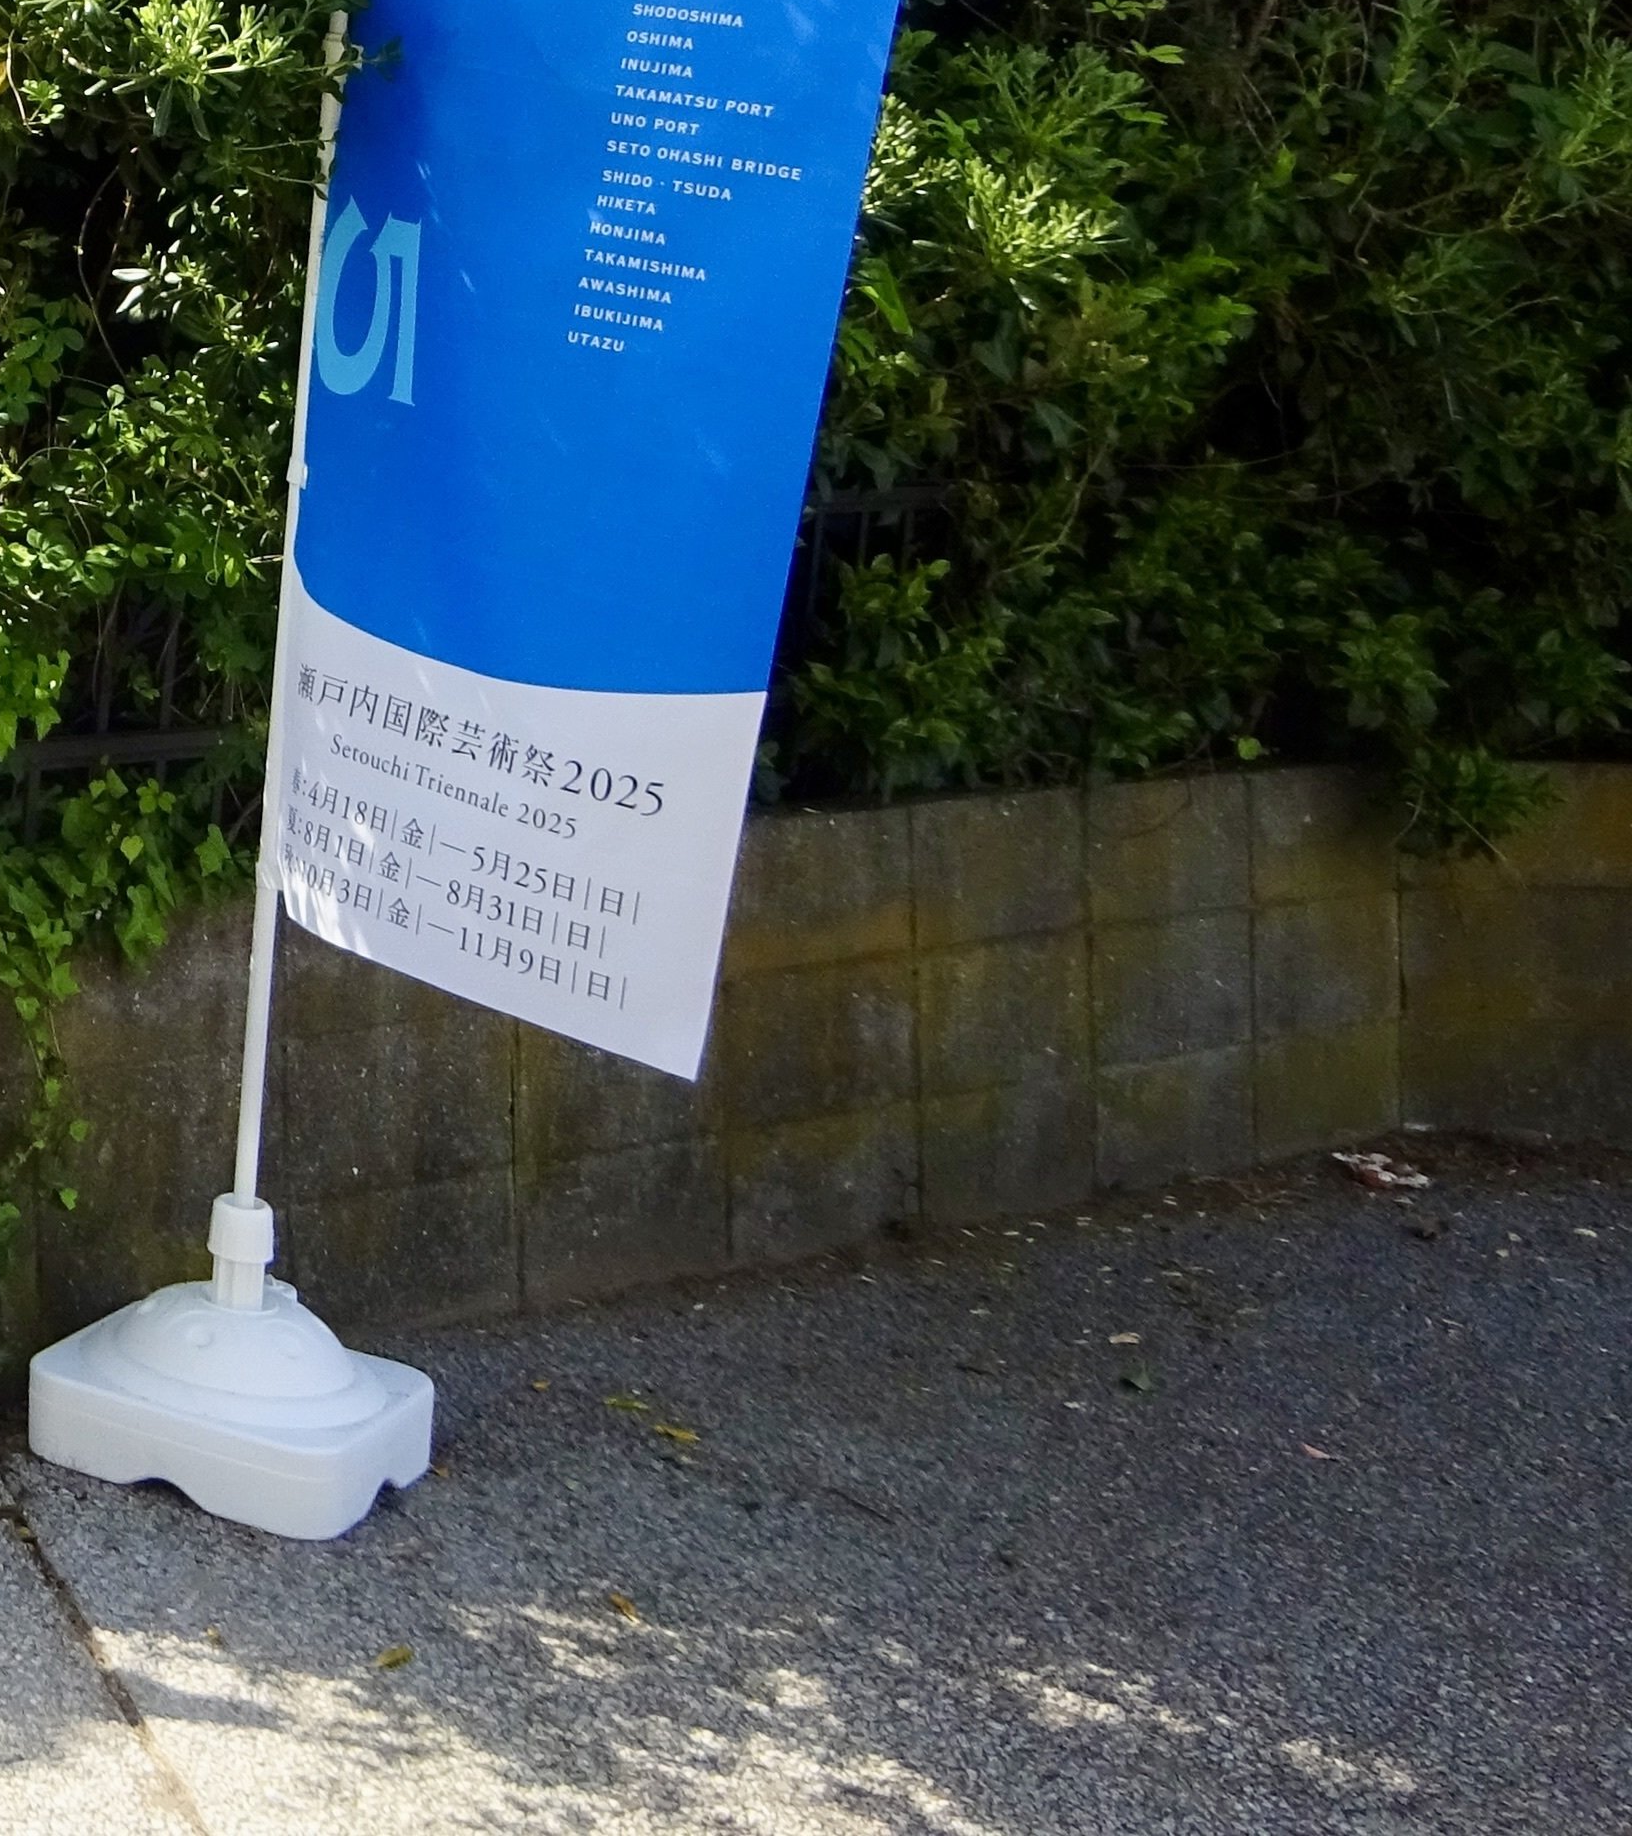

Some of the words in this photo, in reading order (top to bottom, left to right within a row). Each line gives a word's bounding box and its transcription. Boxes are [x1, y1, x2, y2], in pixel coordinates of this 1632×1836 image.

[632, 3, 743, 28] SHODOSHIMA
[627, 30, 693, 50] OSHIMA
[621, 58, 692, 78] INUJIMA
[615, 85, 718, 111] TAKAMATSU
[725, 100, 774, 117] PORT
[611, 112, 647, 129] UNO
[654, 118, 700, 135] PORT
[607, 140, 651, 157] SETO
[657, 148, 722, 168] OHASHI
[731, 158, 802, 181] BRIDGE
[602, 170, 653, 188] SHIDO
[673, 180, 732, 201] TSUDA
[597, 195, 656, 215] HIKETA
[590, 220, 666, 245] HONJIMA
[584, 249, 706, 282] TAKAMISHIMA
[578, 277, 672, 305] AWASHIMA
[573, 303, 664, 332] IBUKIJIMA
[568, 331, 625, 352] UTAZU
[298, 663, 665, 816] 瀬戸内国際芸術祭2025
[330, 733, 411, 781] Setouchi
[415, 763, 509, 818] Triennale
[516, 802, 577, 840] 2025
